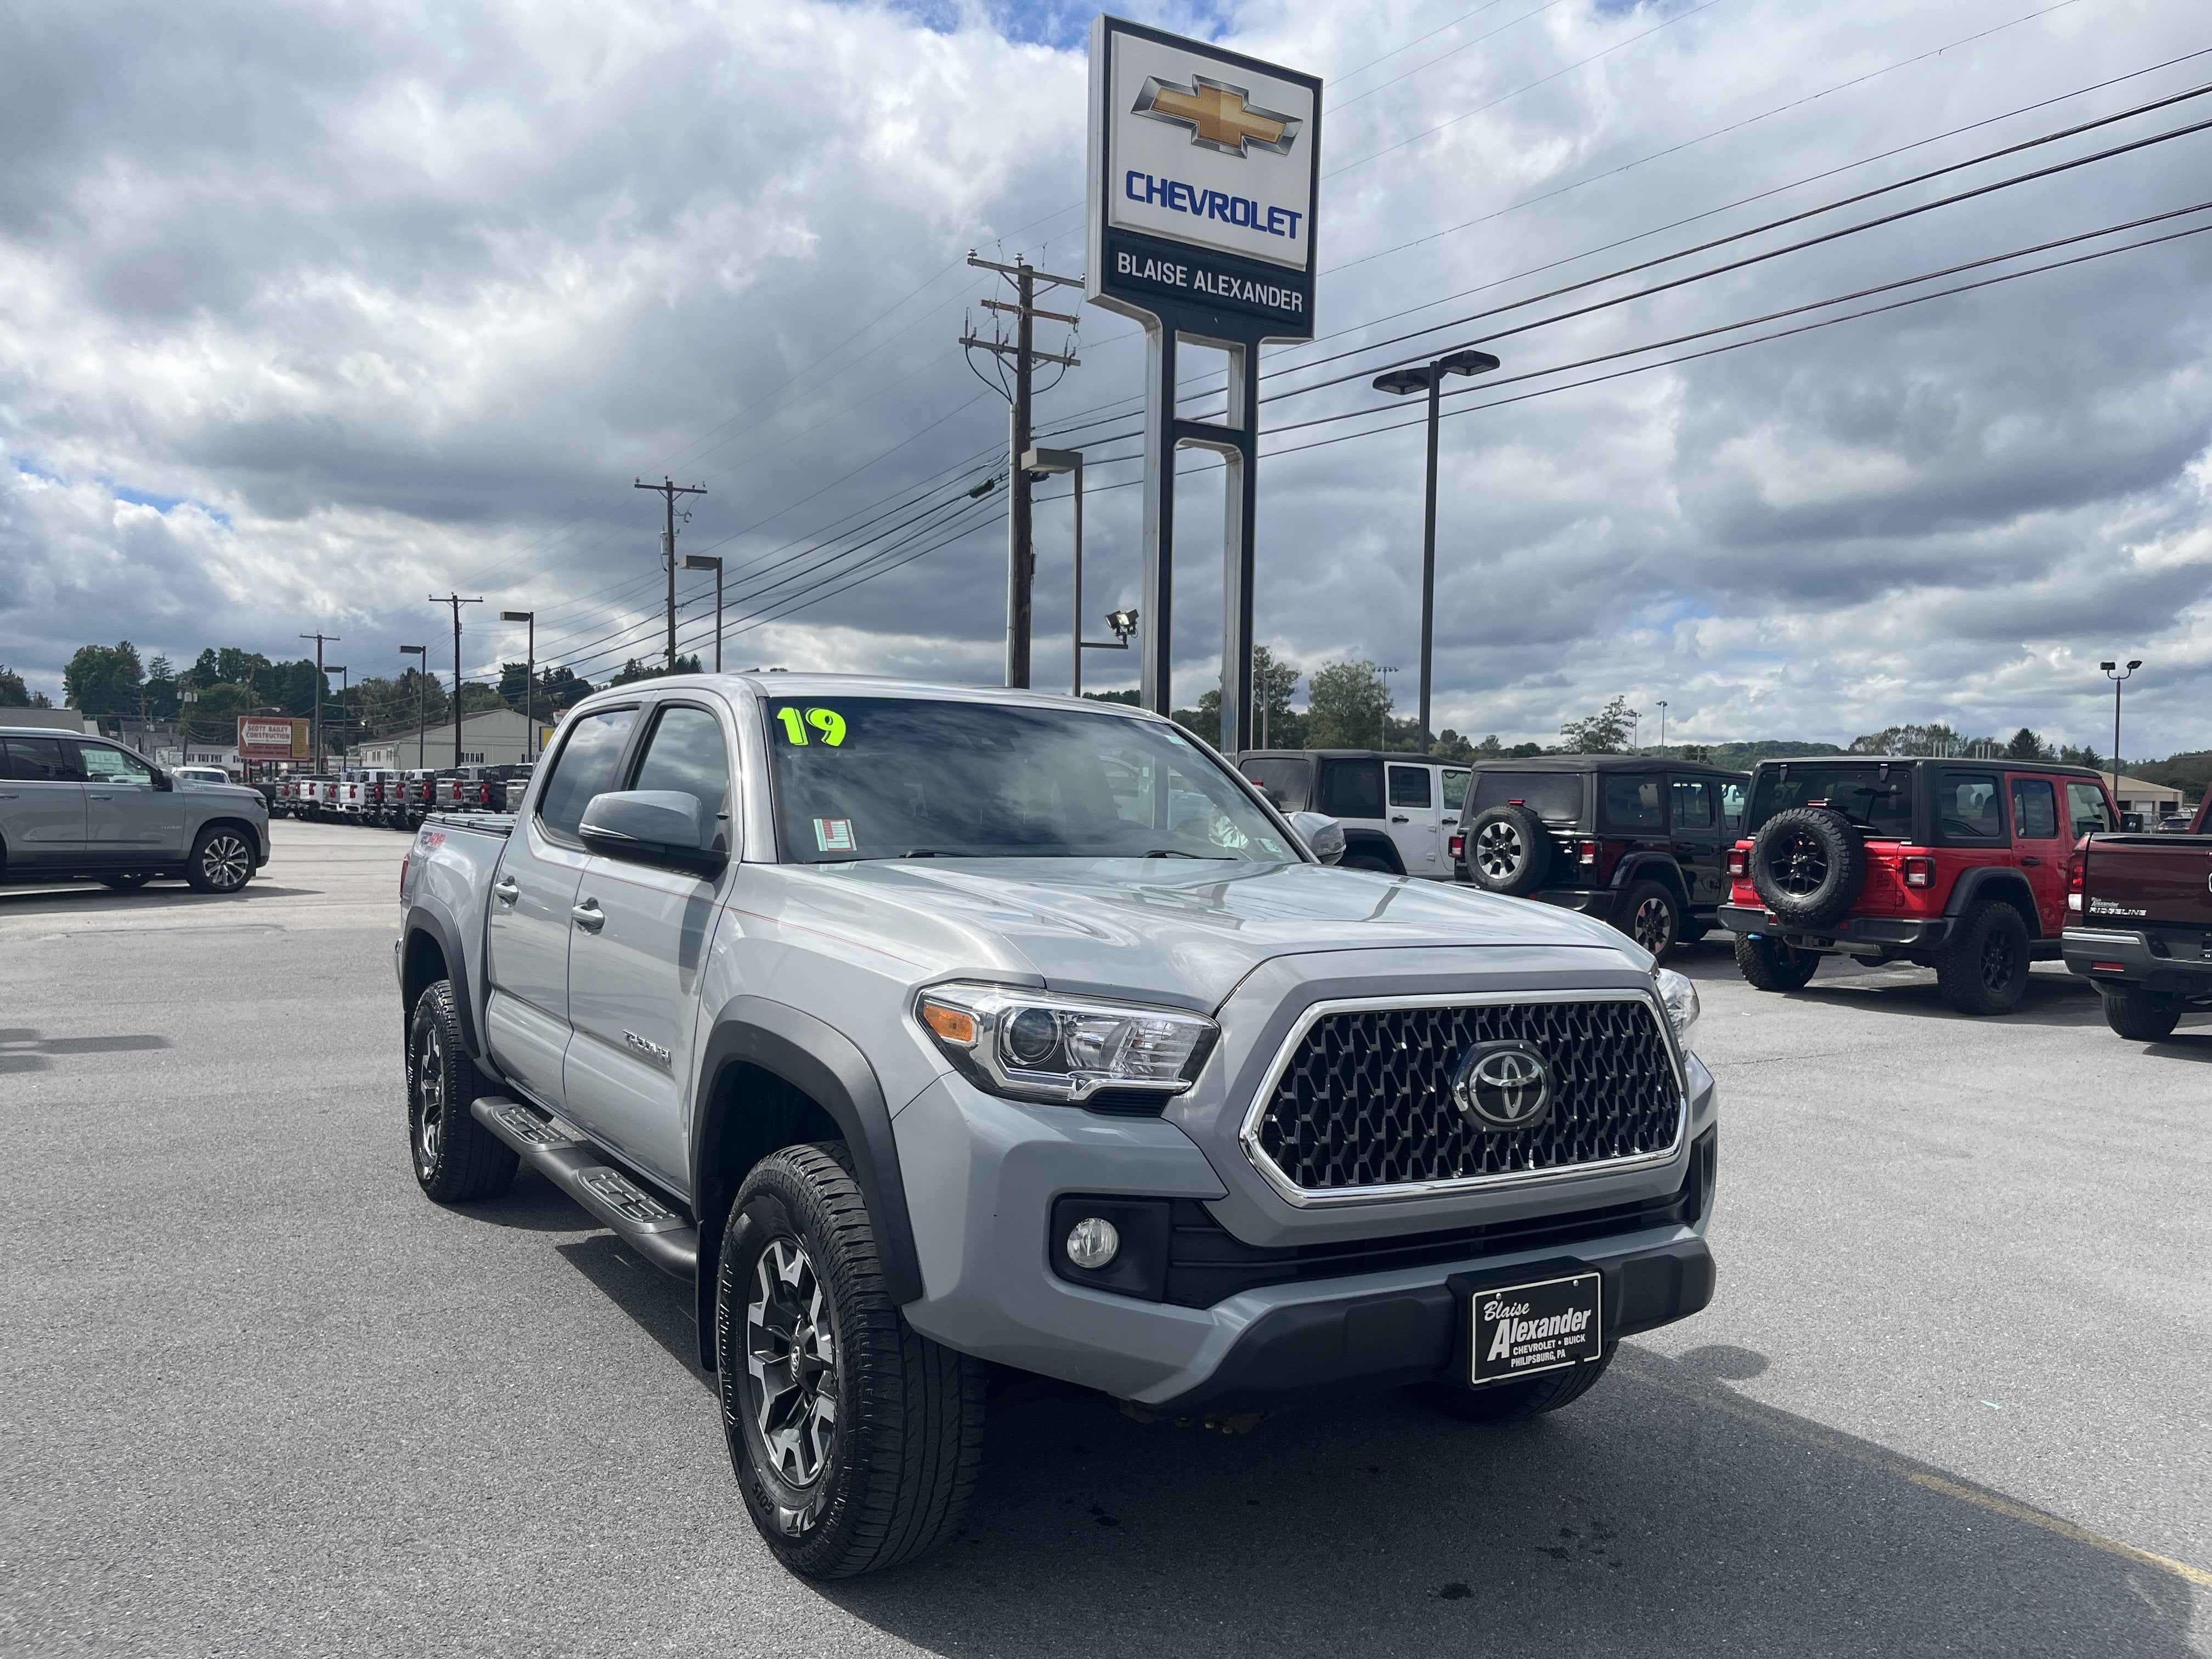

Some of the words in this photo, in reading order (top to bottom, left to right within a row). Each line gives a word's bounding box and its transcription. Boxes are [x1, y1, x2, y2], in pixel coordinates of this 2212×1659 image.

[1126, 170, 1302, 239] CHEVROLET
[1118, 252, 1188, 287] BLAISE
[1193, 270, 1303, 313] ALEXANDER
[777, 707, 847, 747] 19
[2089, 907, 2147, 916] RIDGELINE
[1483, 1300, 1530, 1322] Blaise
[1487, 1307, 1592, 1362] Alexander
[1513, 1339, 1556, 1356] CHEVROLET
[1564, 1334, 1586, 1346] BUICK
[1511, 1352, 1556, 1368] PHILIPSBURG,
[1556, 1349, 1566, 1358] PA
